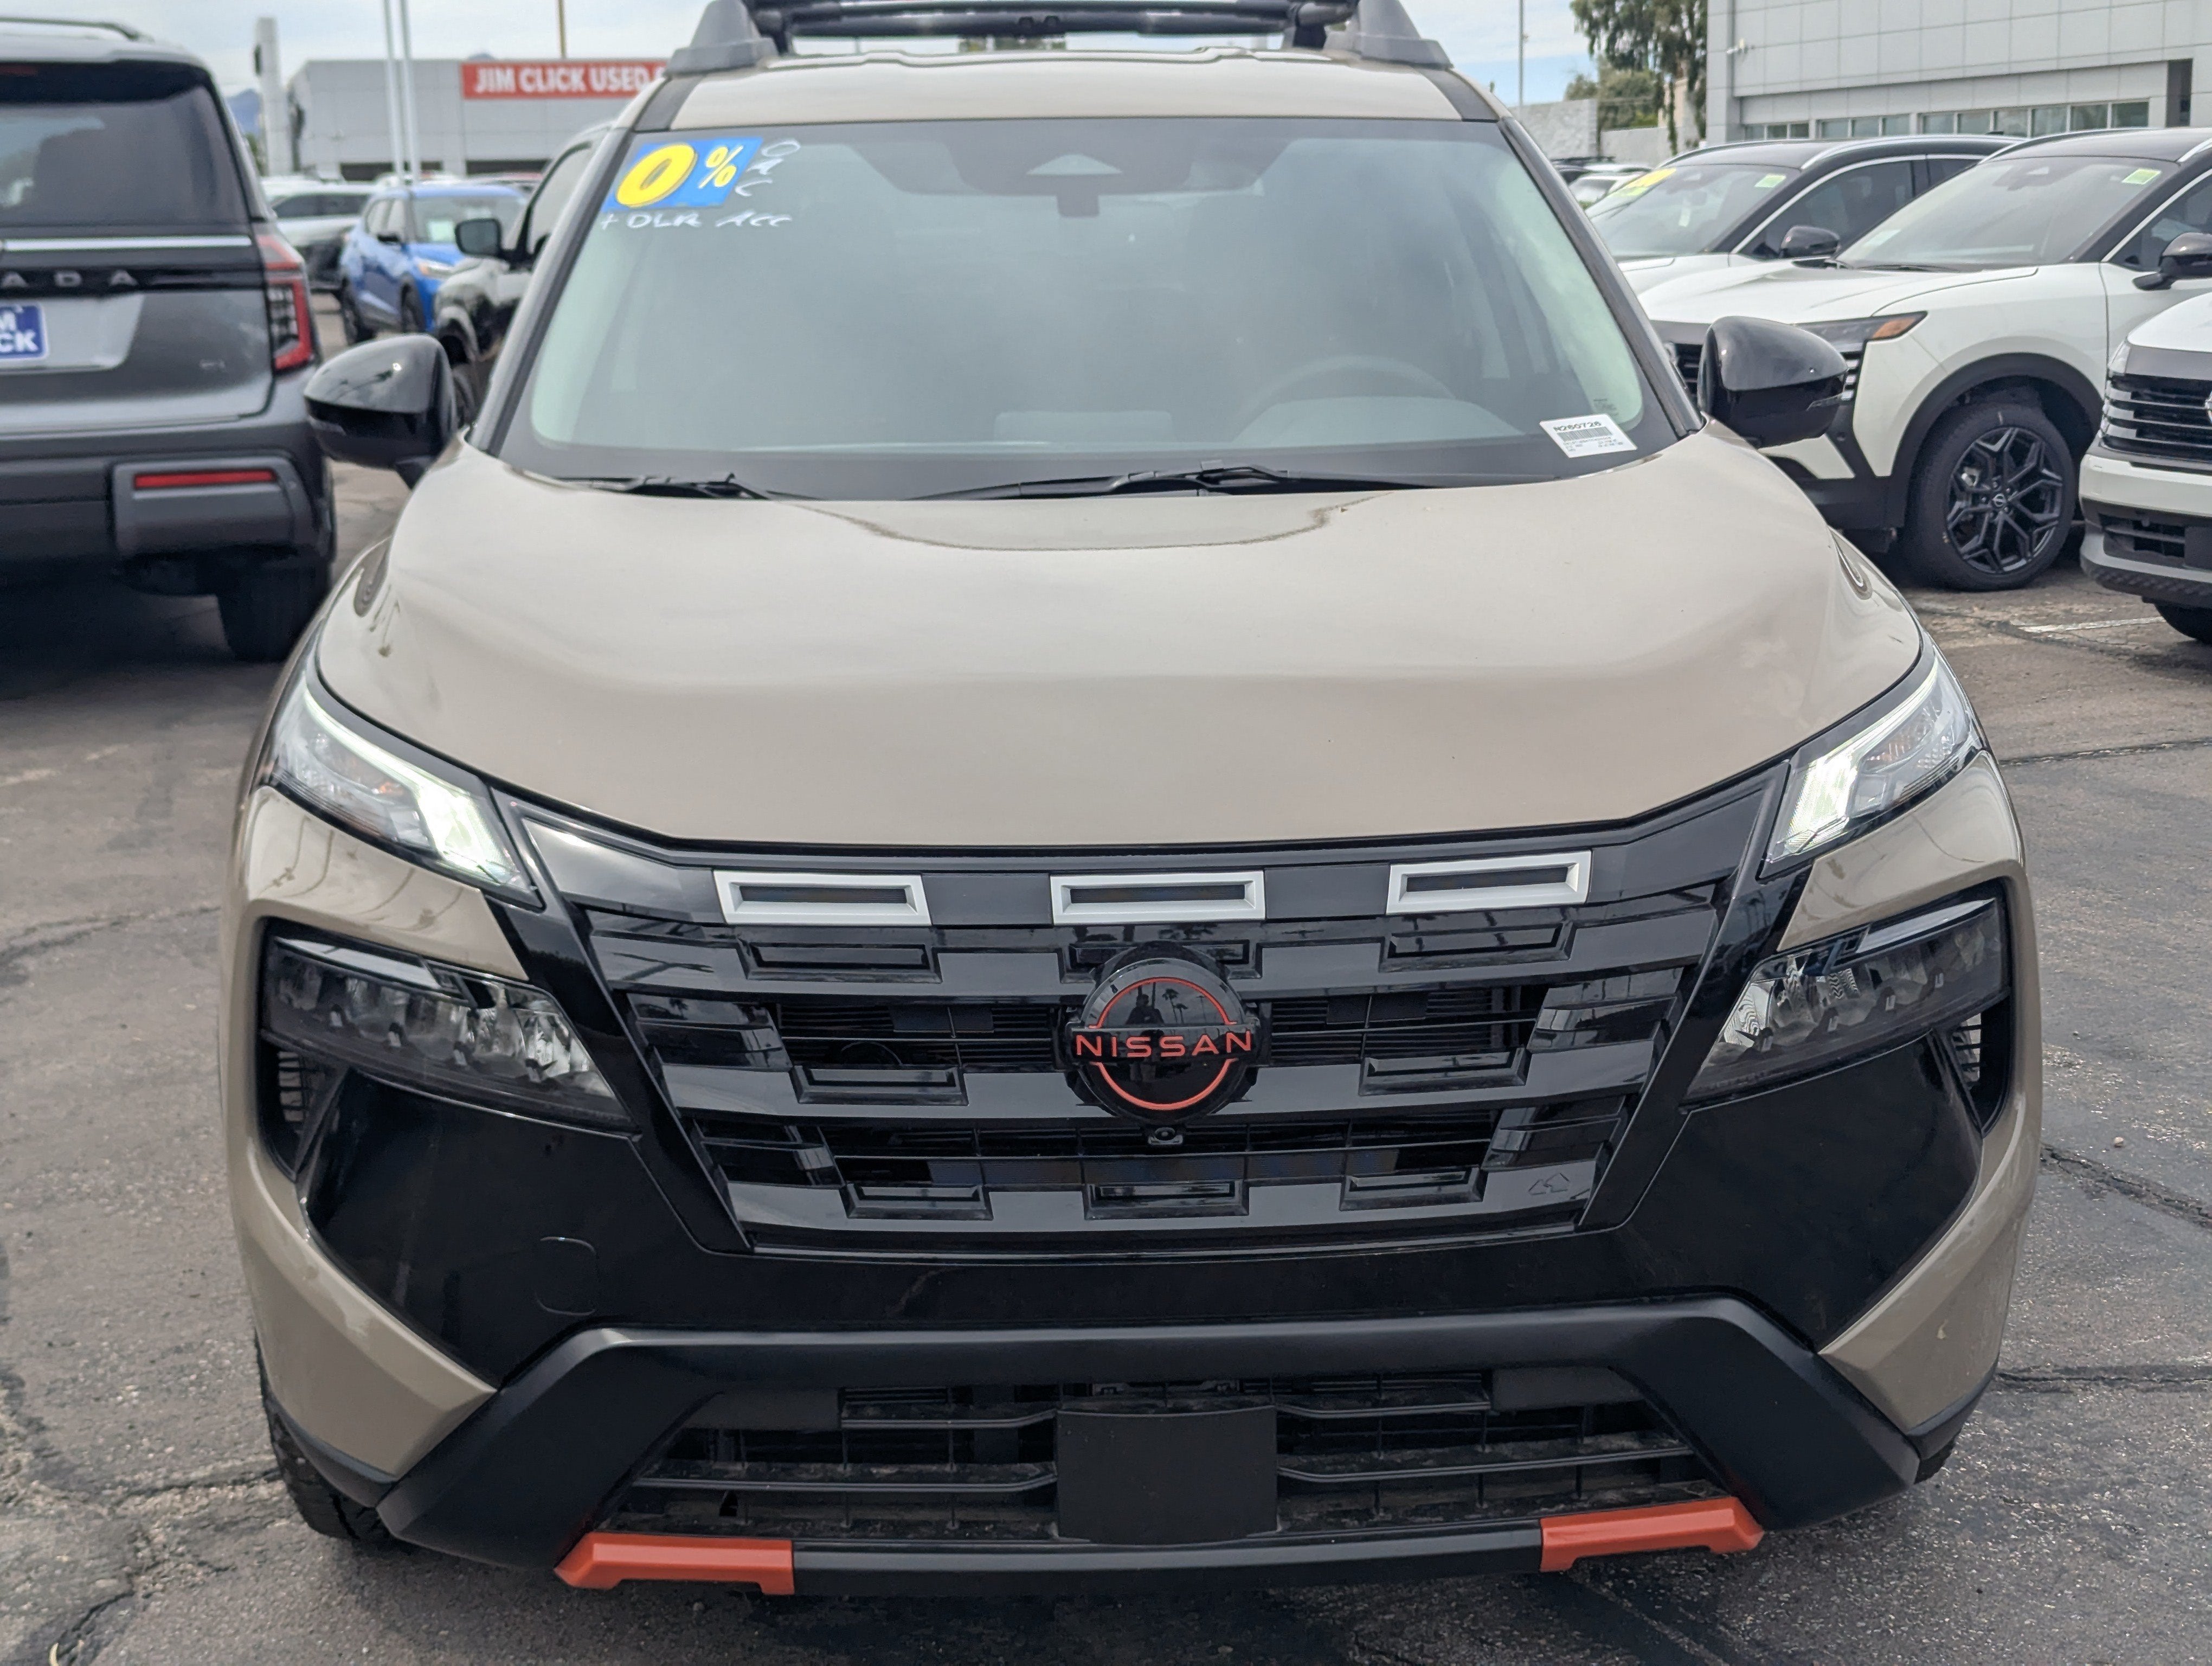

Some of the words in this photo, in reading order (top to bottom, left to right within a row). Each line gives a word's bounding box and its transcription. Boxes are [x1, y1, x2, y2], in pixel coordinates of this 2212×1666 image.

[475, 66, 516, 93] JIM
[518, 66, 587, 93] CLICK
[589, 66, 651, 92] USED
[616, 144, 744, 209] 0%
[1075, 1030, 1251, 1058] NISSAN
